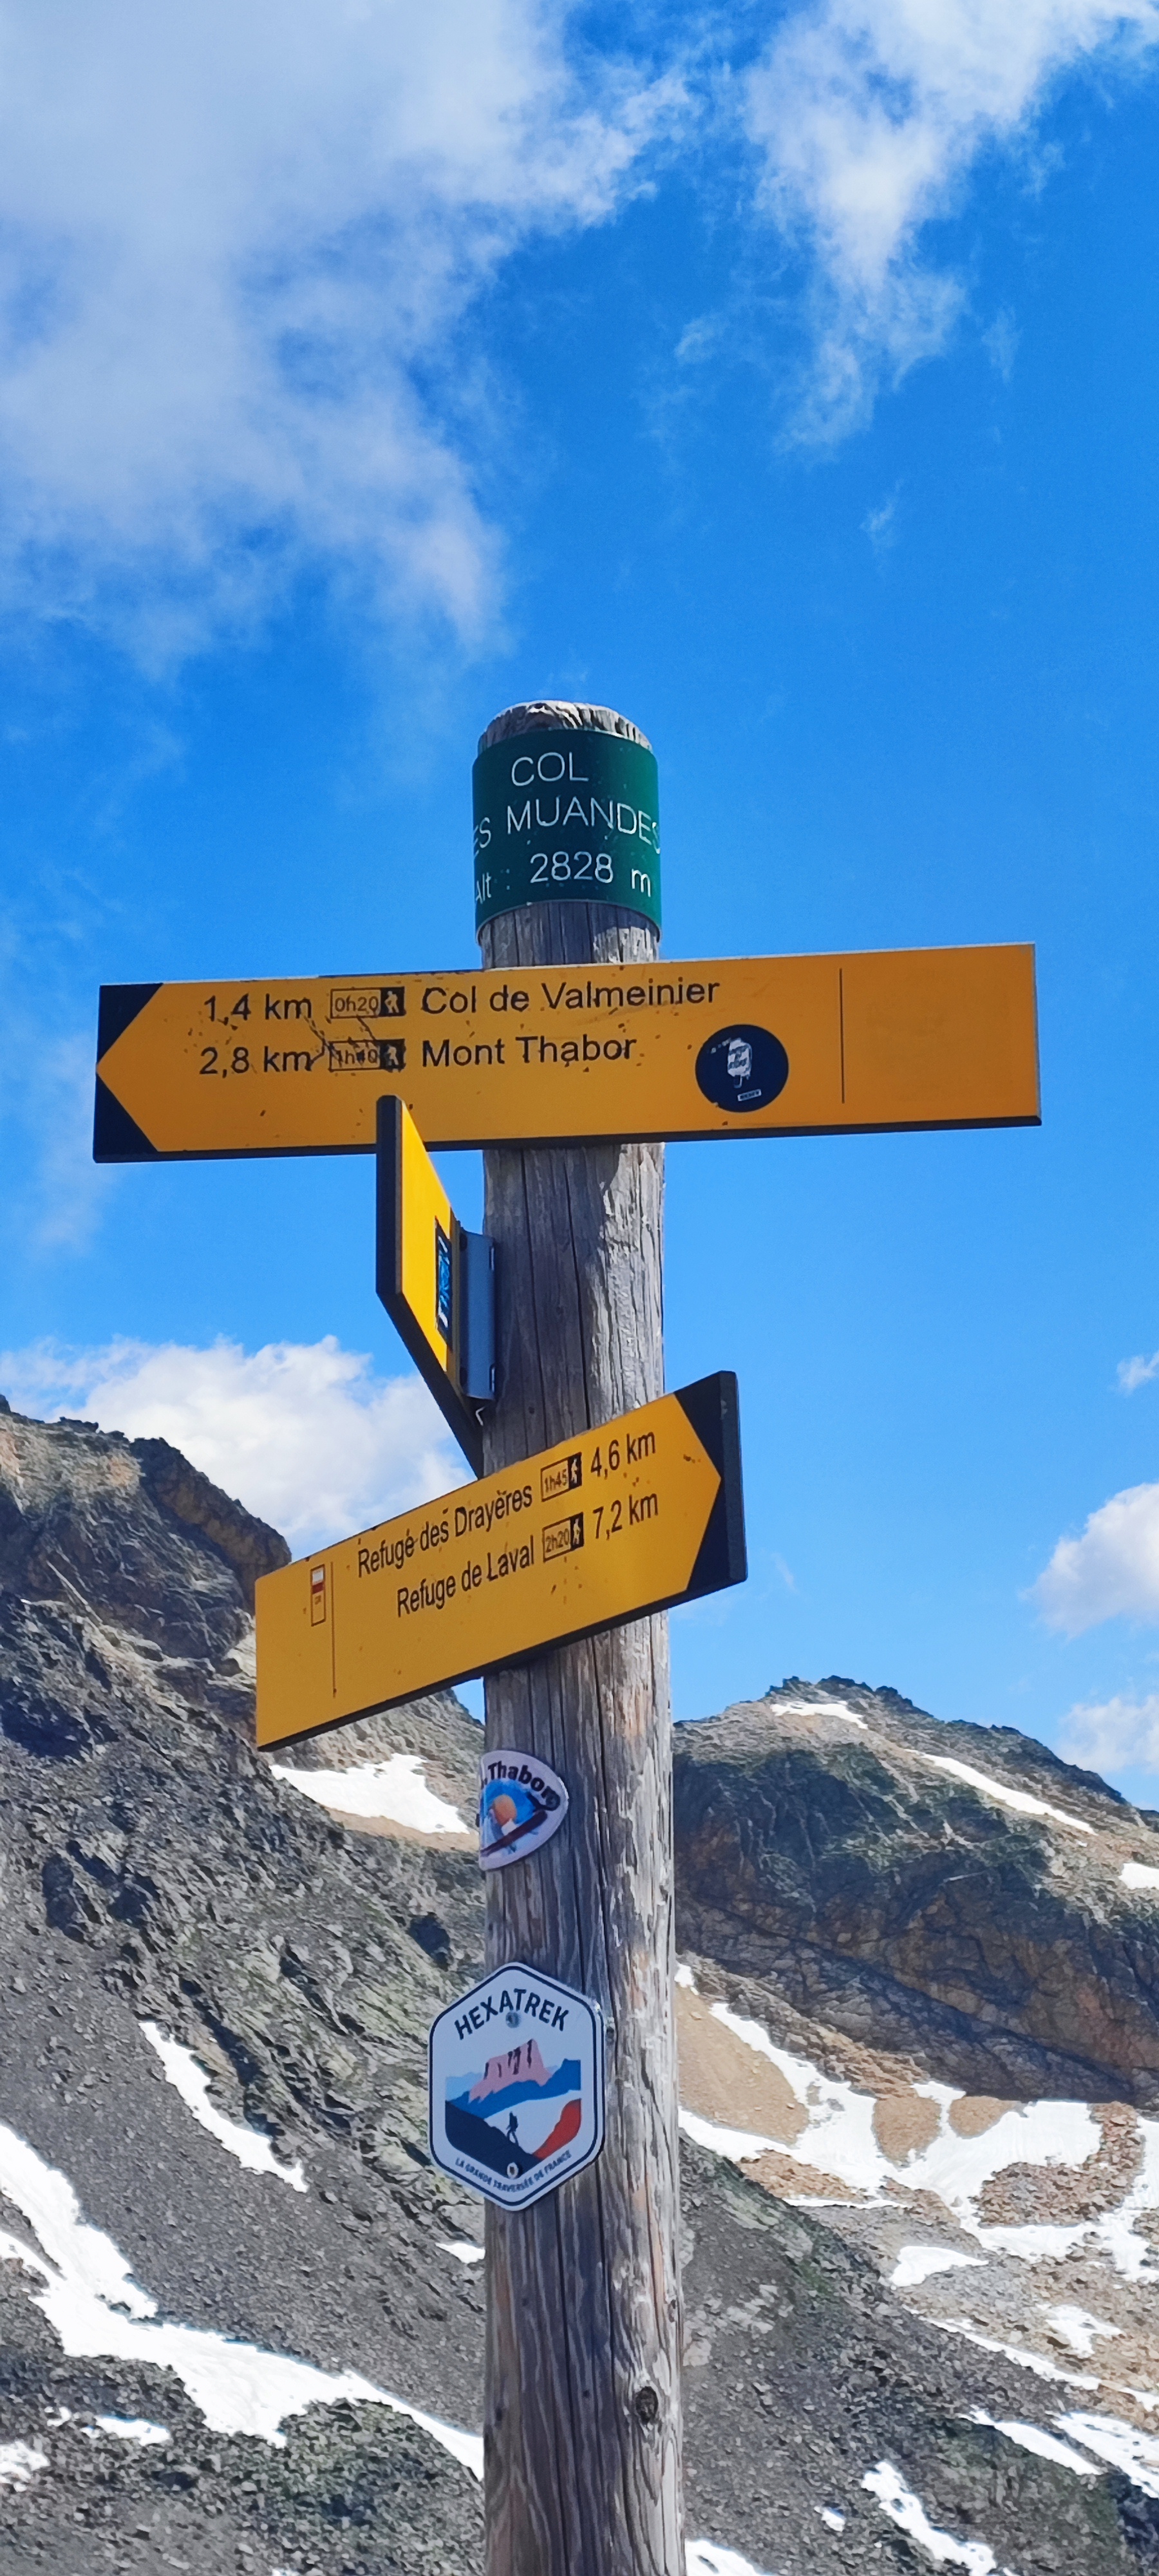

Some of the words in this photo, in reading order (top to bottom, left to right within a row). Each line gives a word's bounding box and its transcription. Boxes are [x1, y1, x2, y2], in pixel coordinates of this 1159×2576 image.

[511, 752, 589, 786] COL
[530, 851, 614, 884] 2828
[631, 868, 651, 897] m
[204, 993, 251, 1026] 1,4
[265, 992, 312, 1020] km
[335, 996, 379, 1012] 0h20
[422, 986, 476, 1014] Col
[489, 984, 529, 1012] de
[541, 976, 720, 1009] Valmeinier
[199, 1046, 249, 1079] 2,8
[263, 1045, 312, 1073] km
[422, 1038, 505, 1067] Mont
[515, 1034, 637, 1063] Thabor
[358, 1539, 415, 1578] Refuge
[419, 1520, 449, 1551] des
[455, 1485, 533, 1537] Drayères
[590, 1439, 620, 1480] 4,6
[627, 1432, 655, 1464] km
[397, 1575, 456, 1618] Refuge
[461, 1560, 482, 1592] de
[486, 1534, 534, 1582] Laval
[592, 1499, 623, 1540] 7,2
[628, 1493, 659, 1525] km
[455, 1989, 569, 2040] HEXATREK
